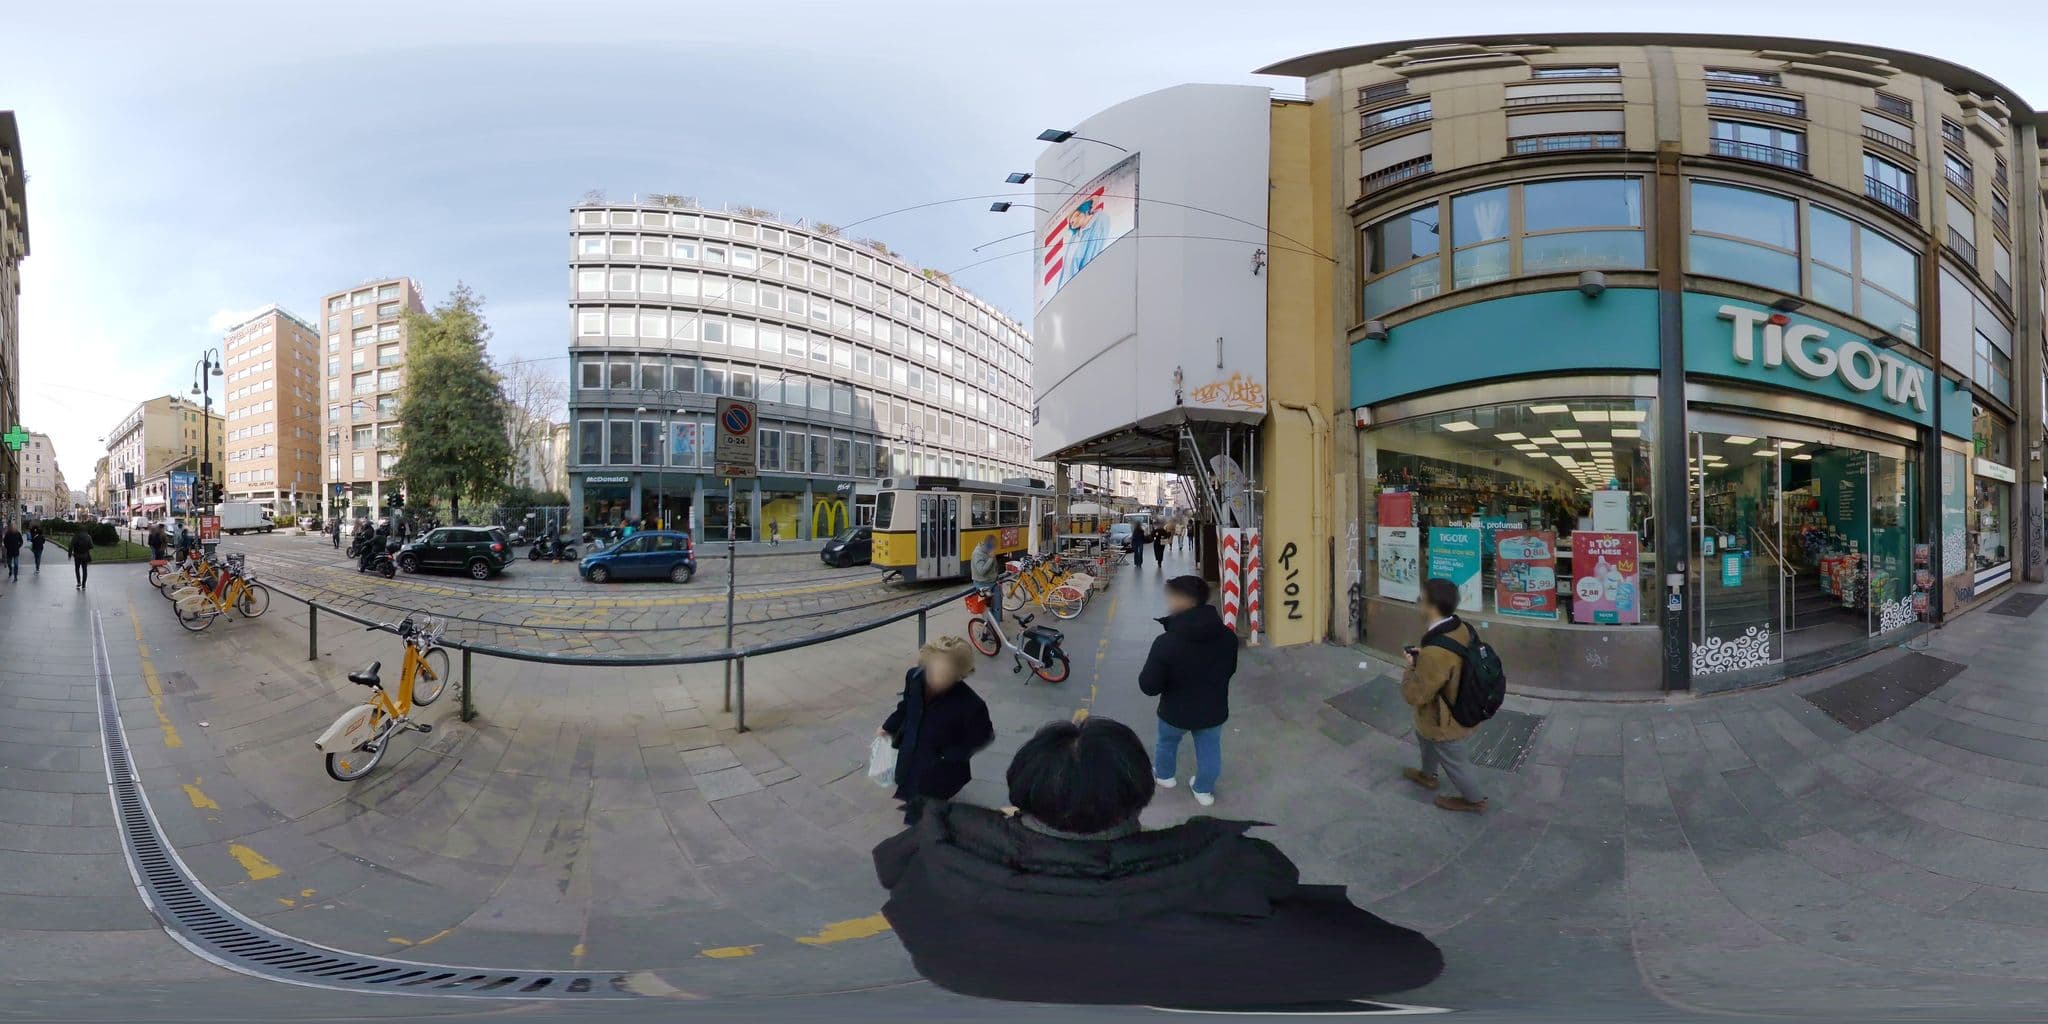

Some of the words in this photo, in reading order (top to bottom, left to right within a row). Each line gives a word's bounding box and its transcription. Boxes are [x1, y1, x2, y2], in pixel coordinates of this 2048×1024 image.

[727, 437, 746, 445] 0-24
[1486, 521, 1523, 530] profumati
[1595, 539, 1620, 548] TOP
